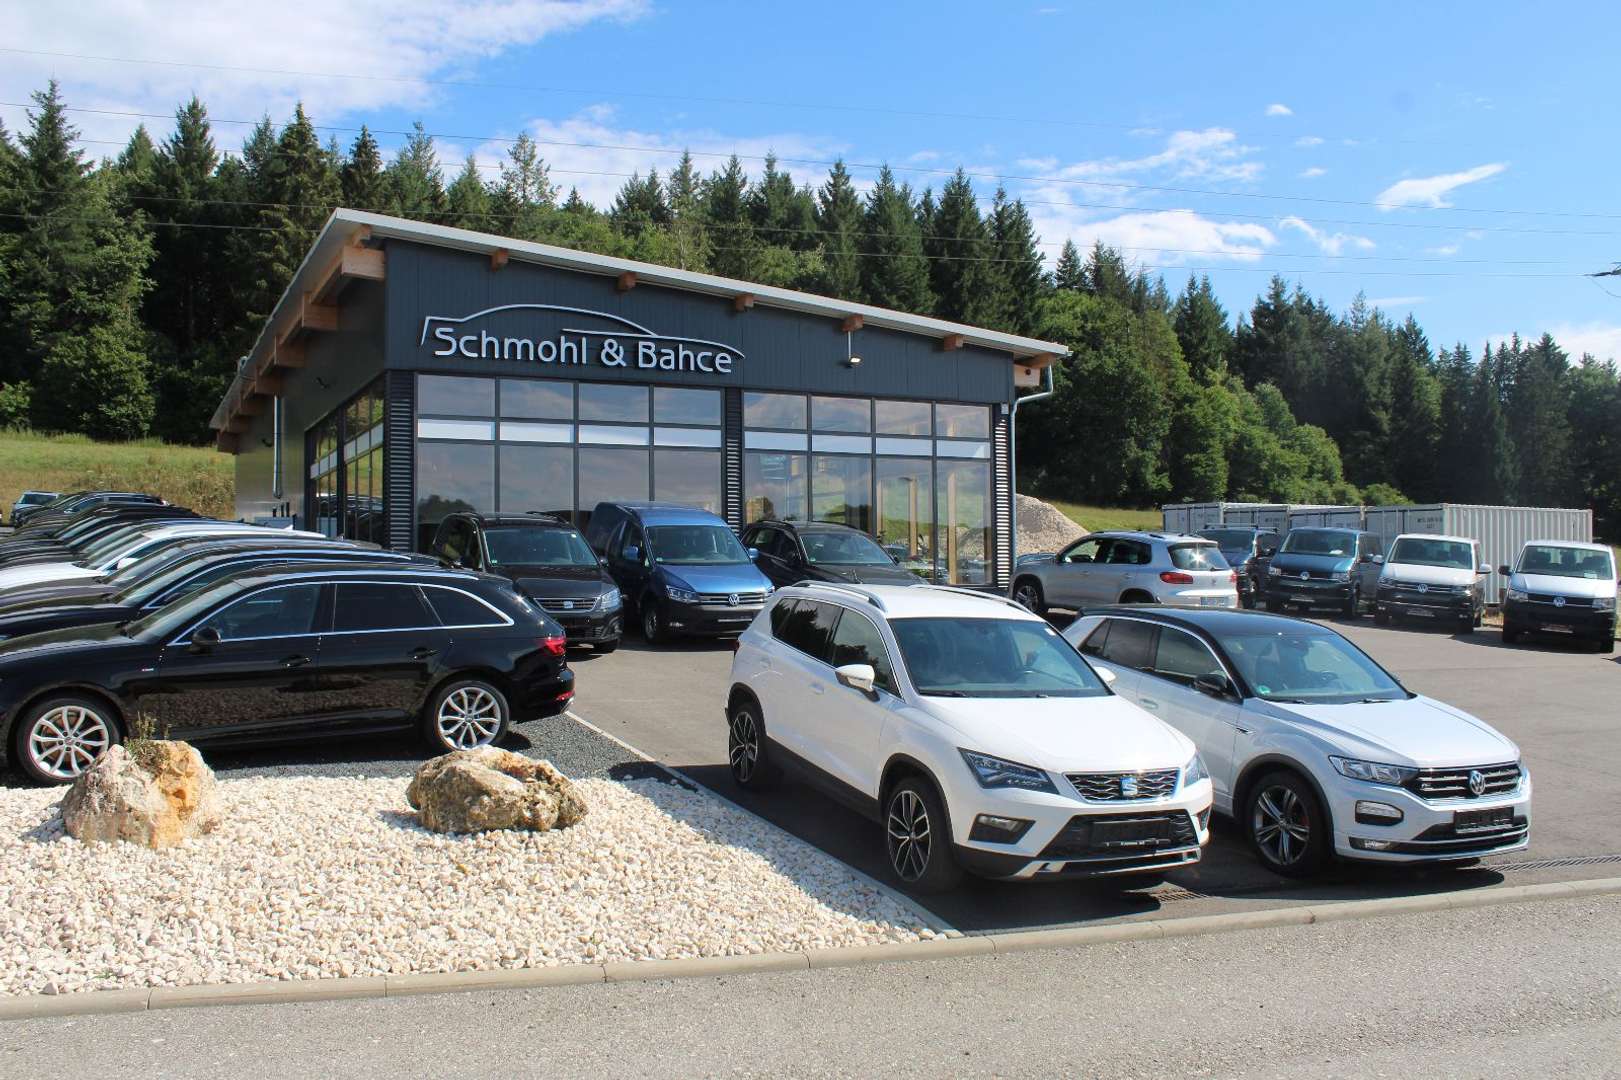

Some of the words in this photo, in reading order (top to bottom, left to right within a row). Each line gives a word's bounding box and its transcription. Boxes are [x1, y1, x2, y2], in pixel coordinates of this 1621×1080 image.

[434, 327, 587, 364] Schmohl
[600, 338, 627, 367] &
[638, 341, 732, 373] Bahce
